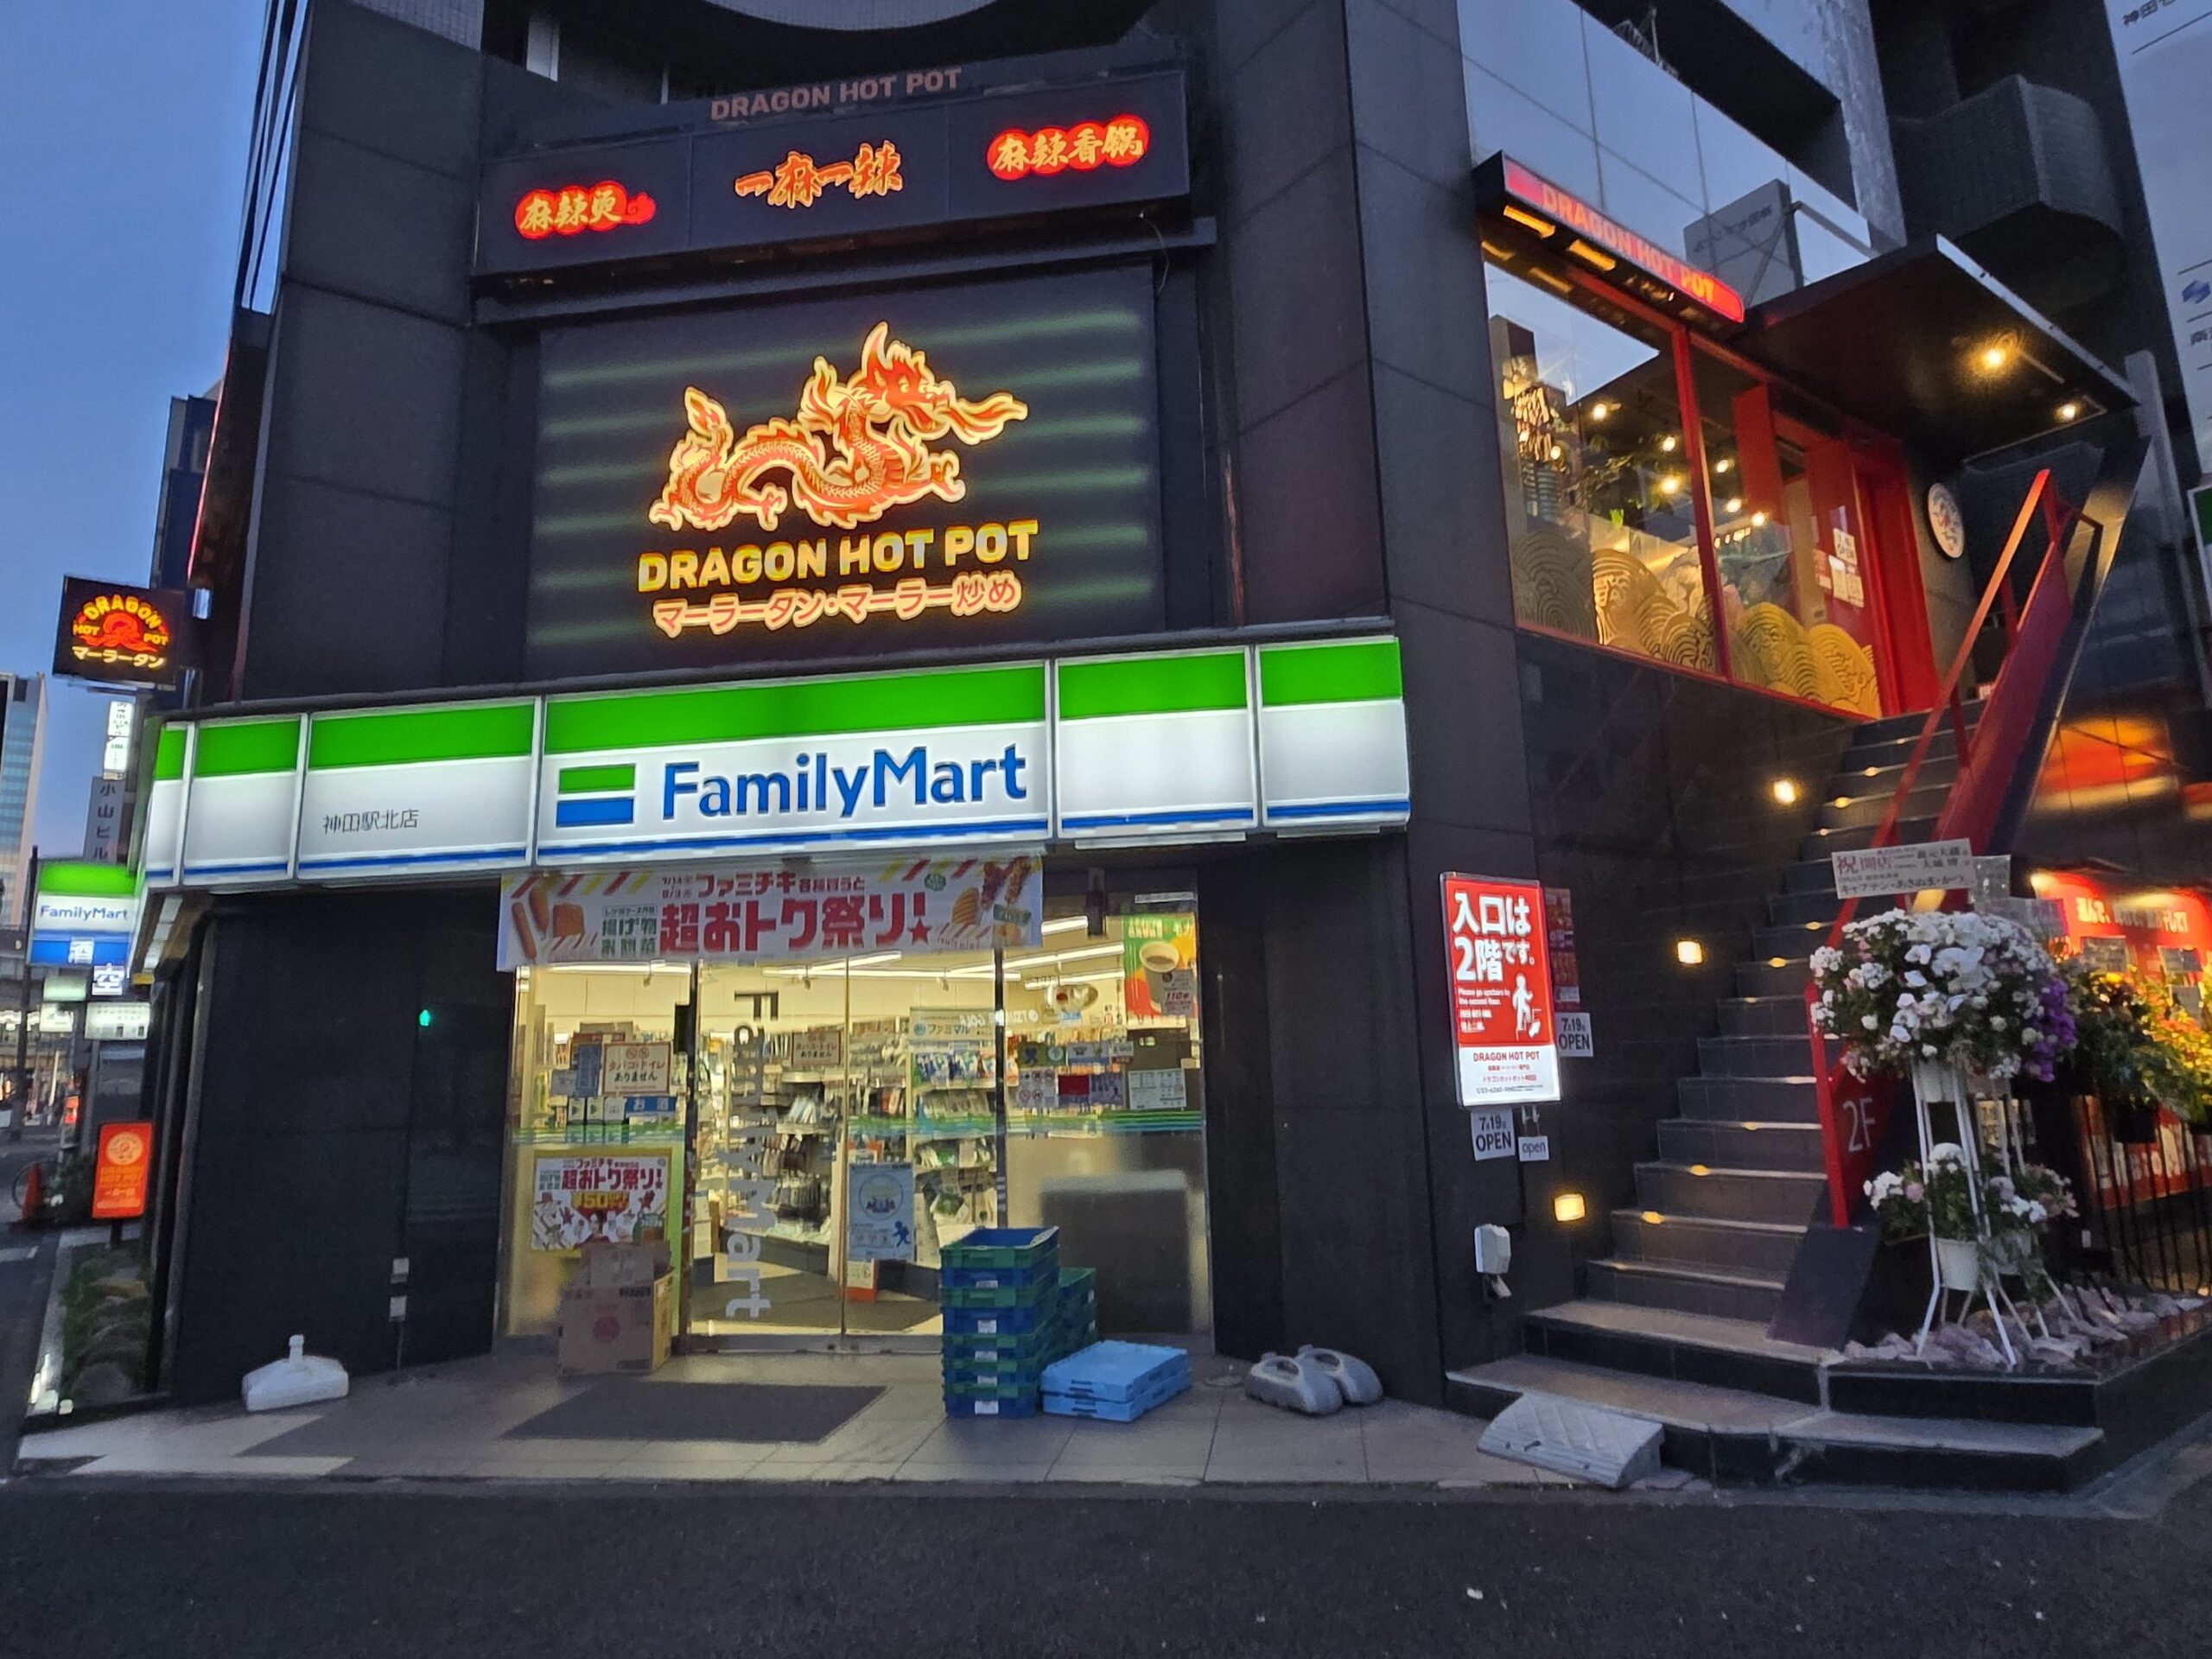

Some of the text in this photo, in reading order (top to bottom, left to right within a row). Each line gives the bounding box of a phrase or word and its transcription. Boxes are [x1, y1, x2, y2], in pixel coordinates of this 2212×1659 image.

[710, 67, 962, 120] DRAGON HOT POT
[1543, 183, 1714, 302] DRAGON HOT POT
[638, 520, 1039, 592] DRAGON HOT POT
[84, 594, 162, 629] DRAGON
[653, 570, 1021, 637] マーラータン・マーラー炒め
[73, 623, 168, 645] HOT POT
[72, 646, 166, 668] マーラータン
[663, 743, 1027, 820] FamilyMart
[93, 783, 117, 861] 小山ビル
[322, 809, 419, 835] 神田駅北店
[41, 906, 127, 921] FamilyMart
[1452, 891, 1531, 938] 入口は
[1453, 937, 1535, 982] 2階です。
[1473, 1051, 1540, 1062] DRAGON HOT POT
[1559, 1033, 1591, 1051] OPEN
[613, 1071, 658, 1082] ありません
[1476, 1131, 1512, 1152] OPEN
[1843, 1097, 1876, 1153] 2F
[1522, 1141, 1546, 1159] open
